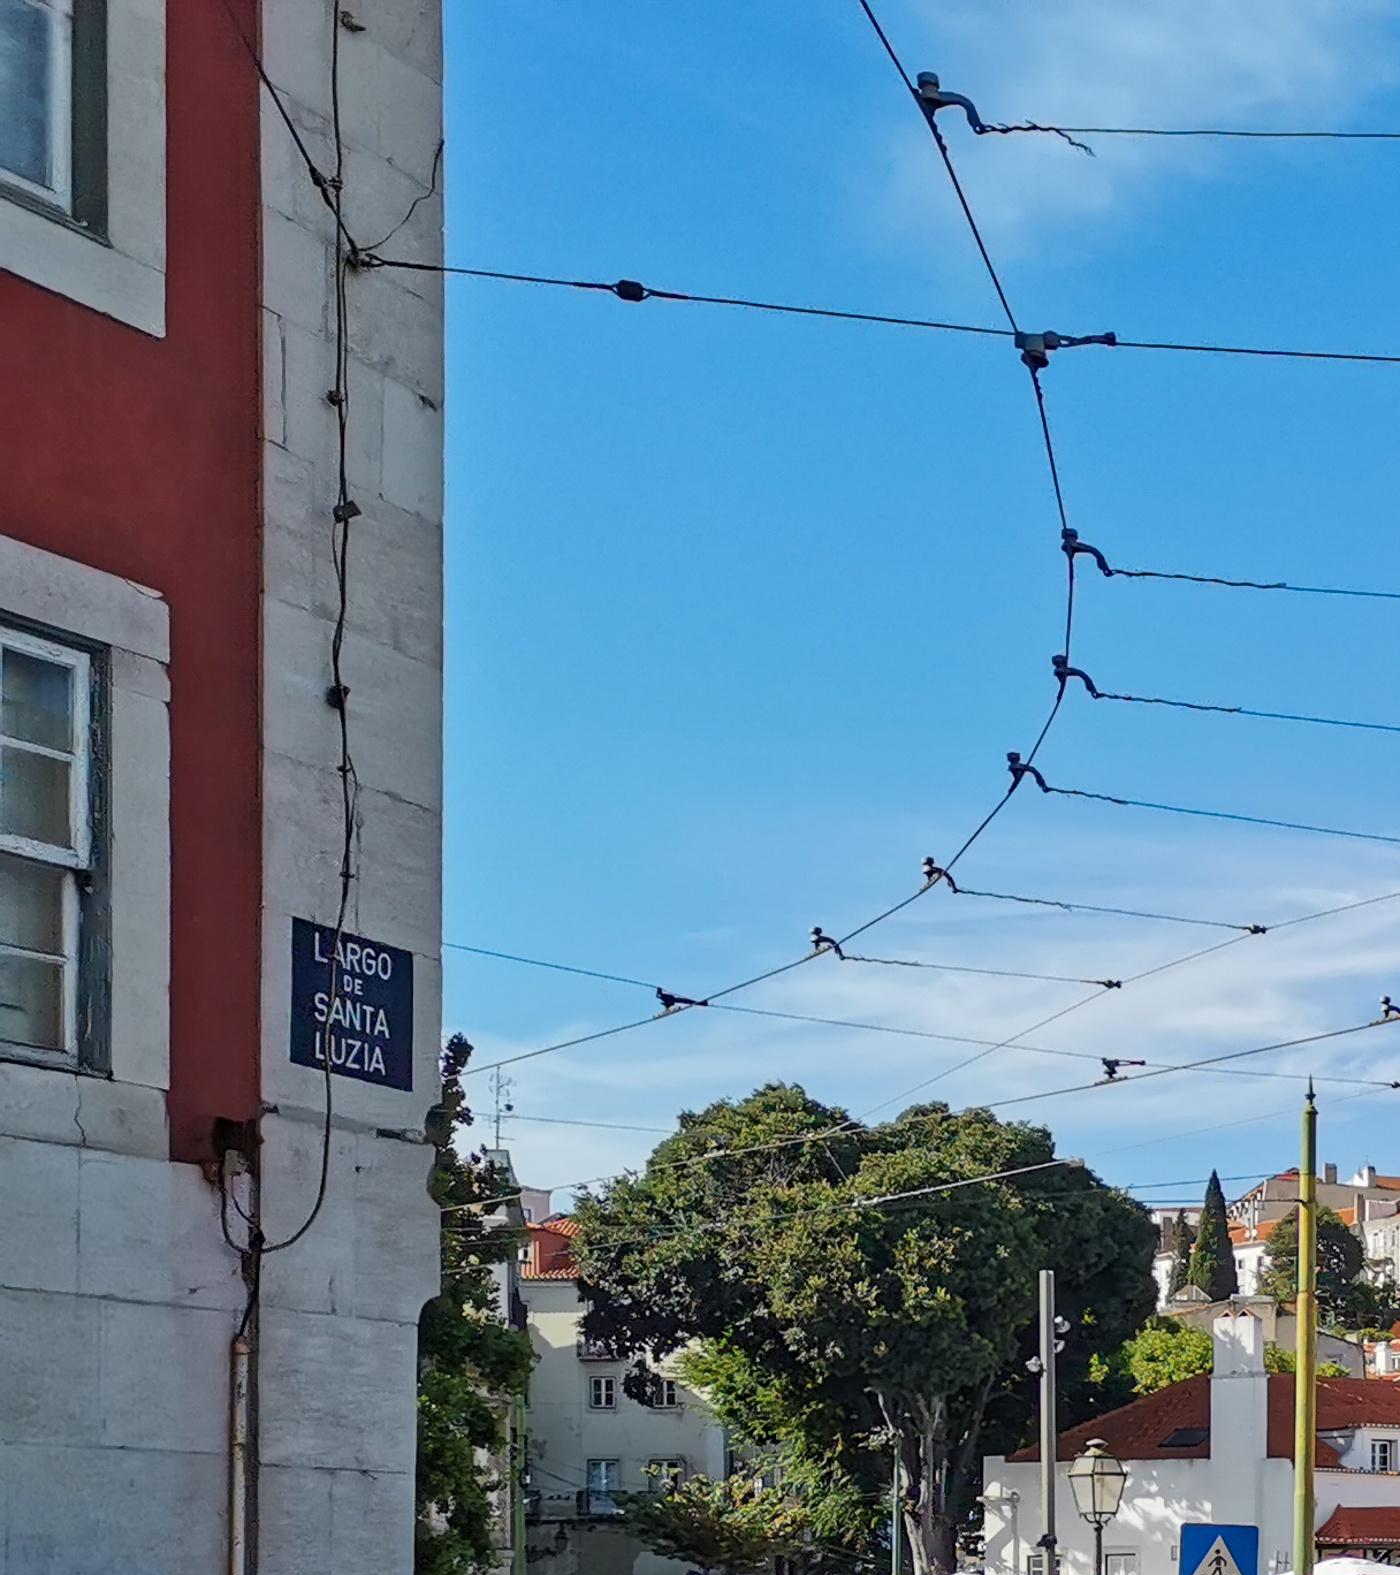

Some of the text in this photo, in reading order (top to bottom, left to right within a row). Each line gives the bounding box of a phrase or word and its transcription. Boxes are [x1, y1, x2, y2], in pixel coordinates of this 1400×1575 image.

[313, 931, 392, 981] LARGO
[343, 974, 364, 996] DE
[313, 992, 391, 1039] SANTA
[314, 1031, 386, 1076] LUZIA
